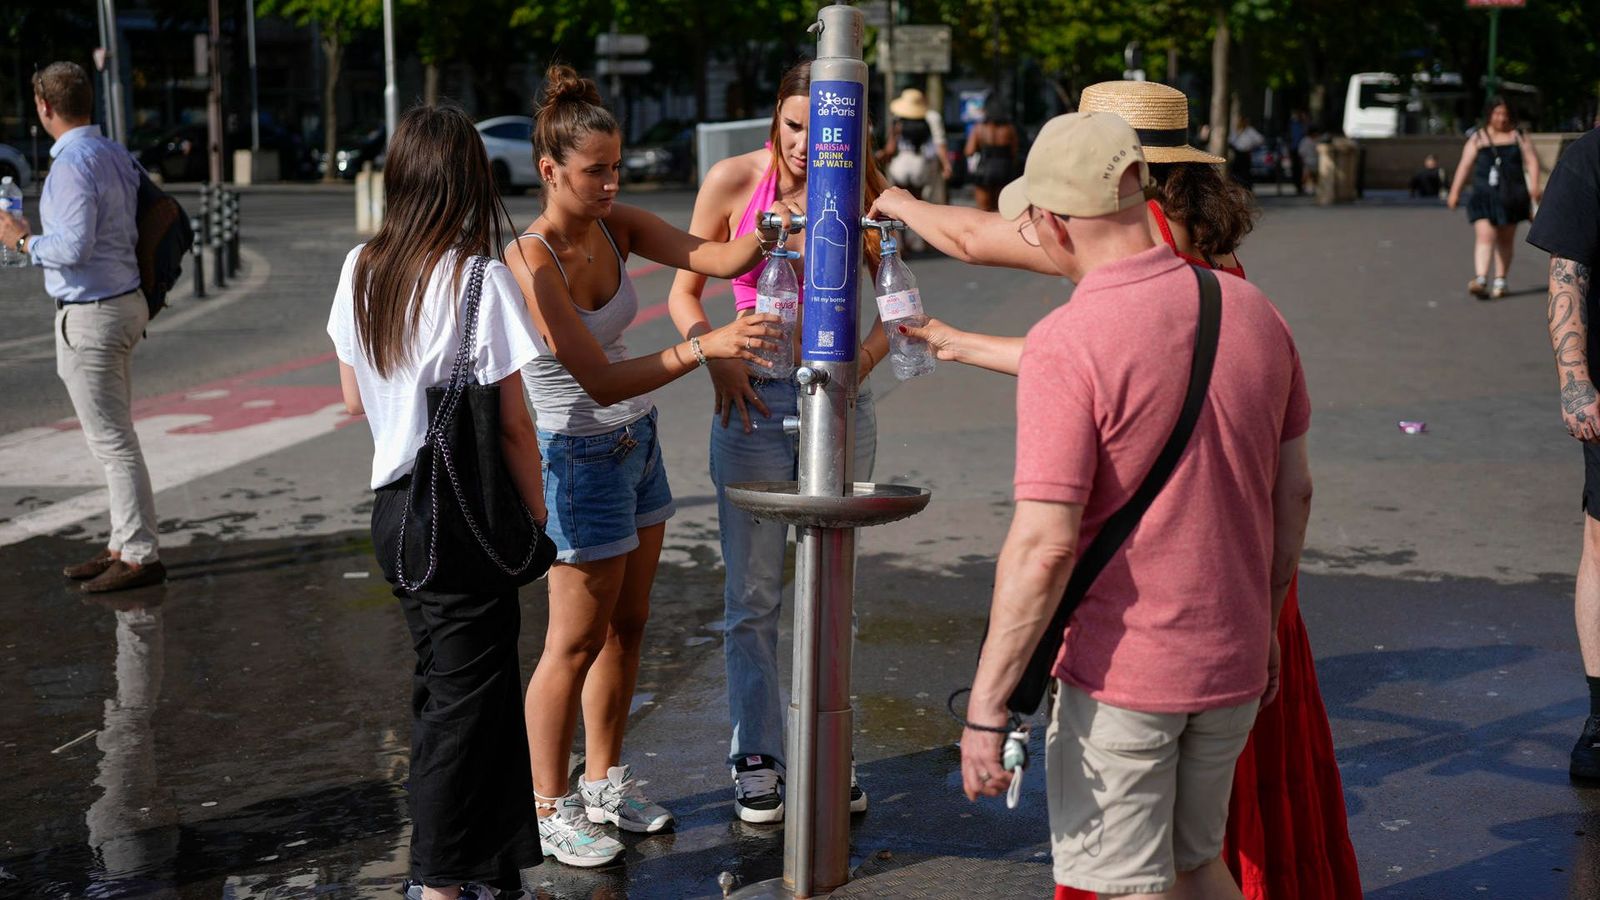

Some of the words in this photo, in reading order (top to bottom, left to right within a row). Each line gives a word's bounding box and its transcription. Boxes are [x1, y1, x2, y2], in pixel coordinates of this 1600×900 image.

[834, 97, 855, 106] eau
[818, 108, 829, 116] de
[831, 108, 855, 117] Paris
[822, 128, 842, 143] BE
[1103, 150, 1126, 179] HUGO
